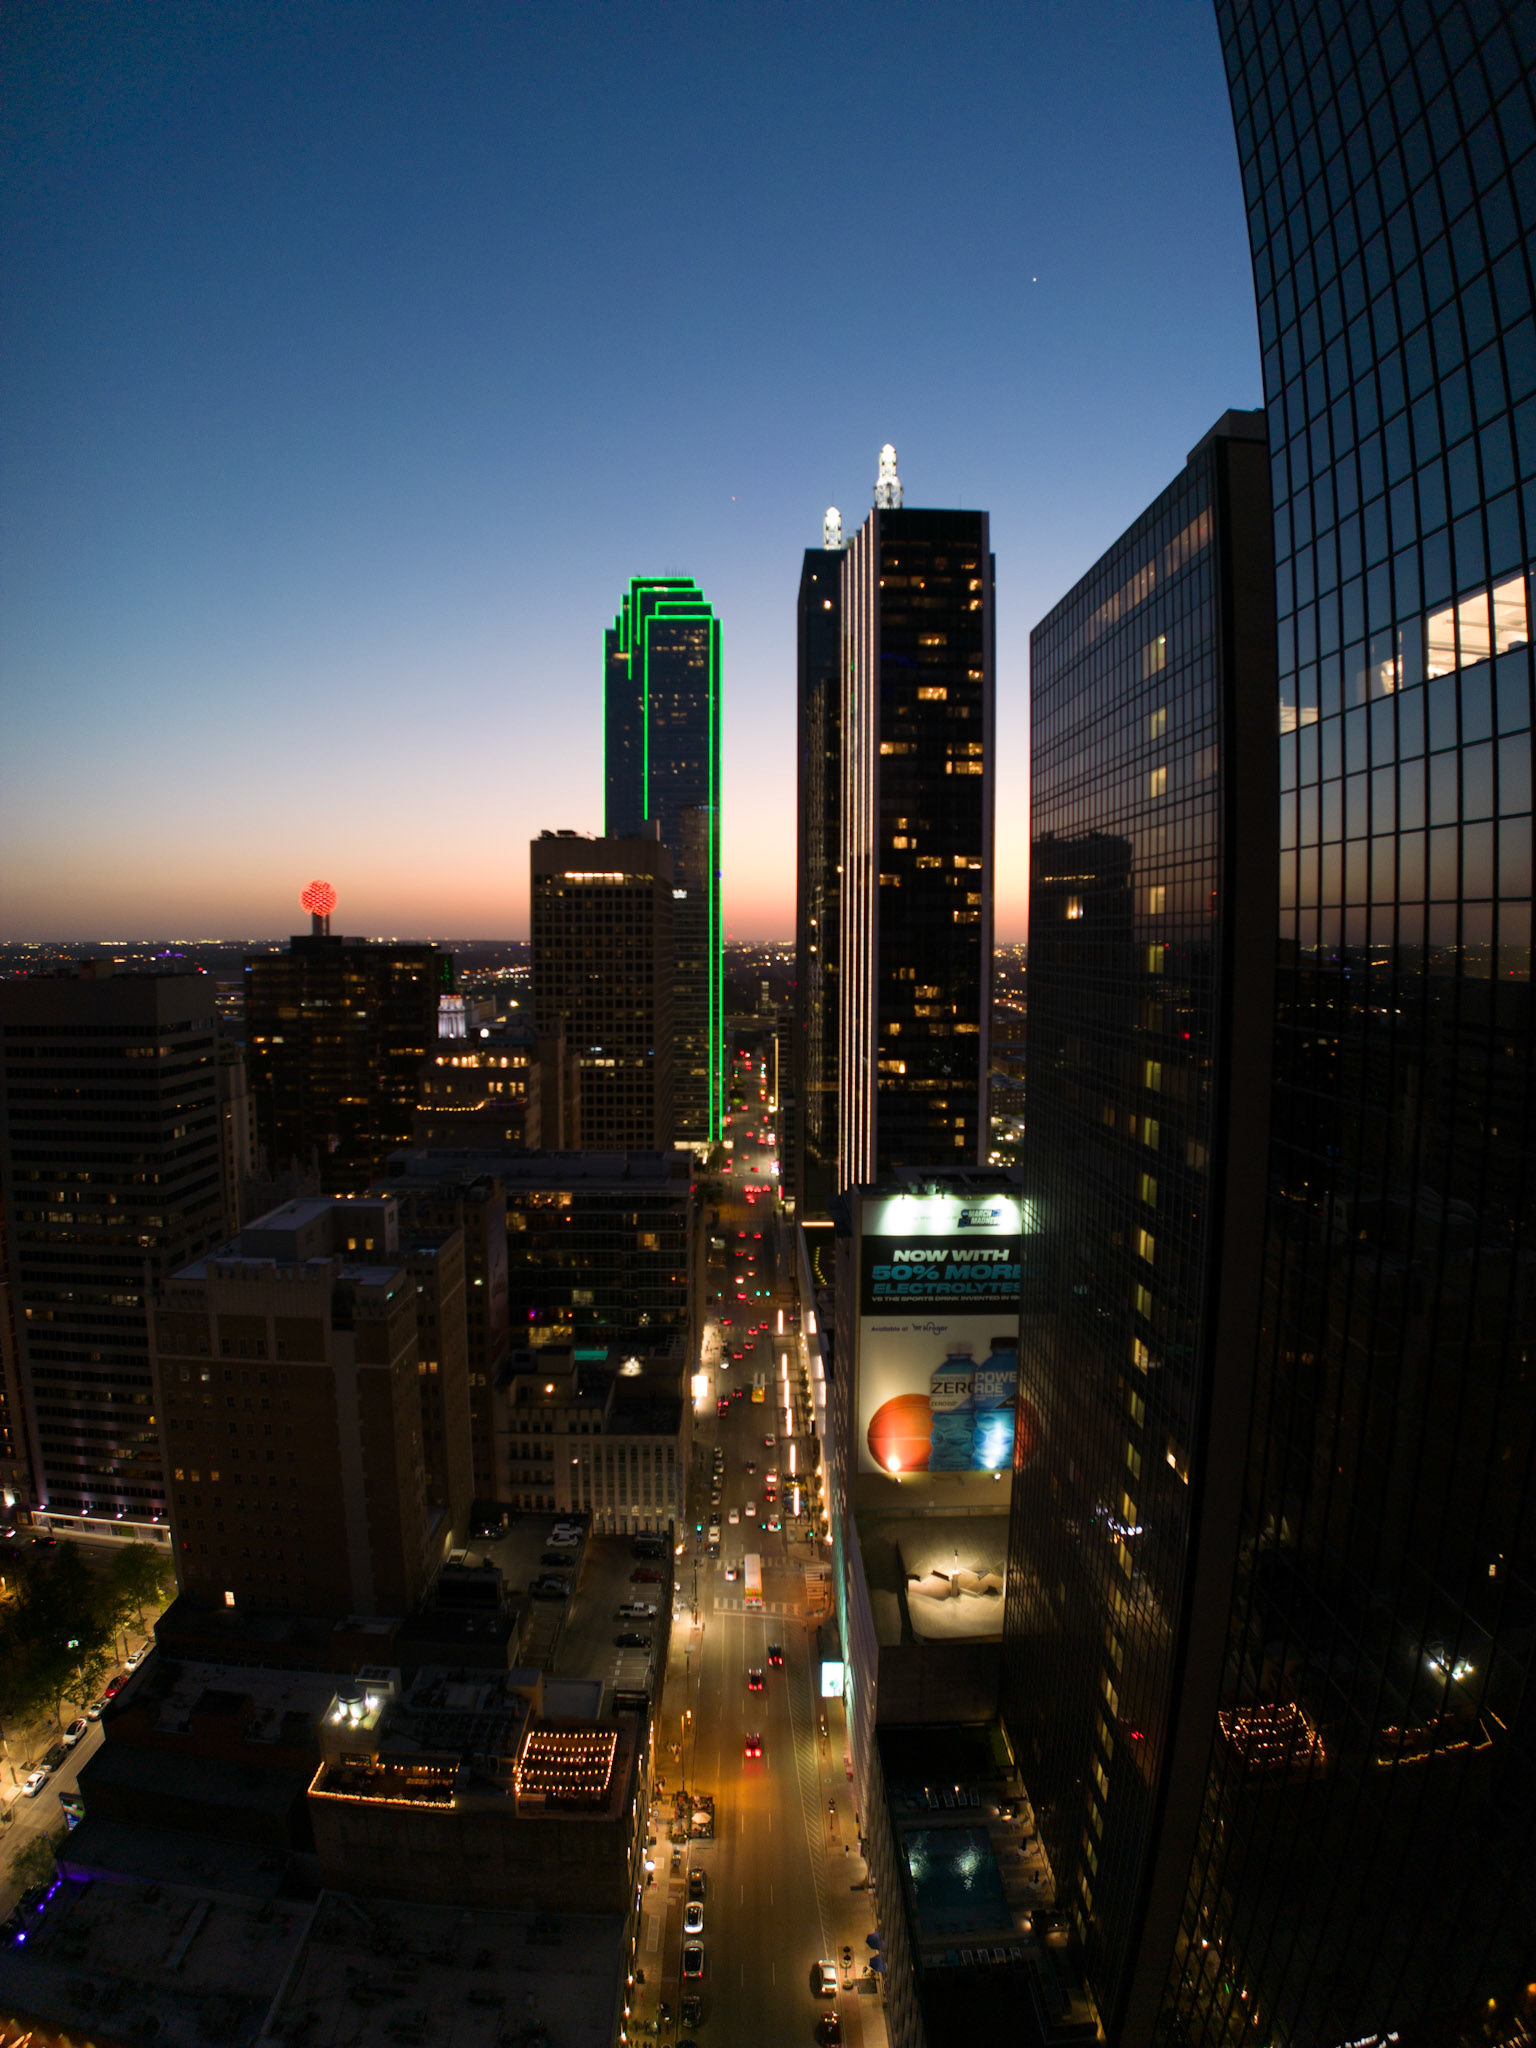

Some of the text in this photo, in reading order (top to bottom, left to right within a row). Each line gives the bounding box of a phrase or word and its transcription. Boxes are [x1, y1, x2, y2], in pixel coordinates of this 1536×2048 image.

[968, 1209, 992, 1217] MARCH
[970, 1217, 1001, 1225] MADNE
[893, 1249, 1010, 1263] NOW WITH
[872, 1264, 940, 1281] 50%
[923, 1321, 948, 1336] Kroger
[975, 1383, 1005, 1394] ADE
